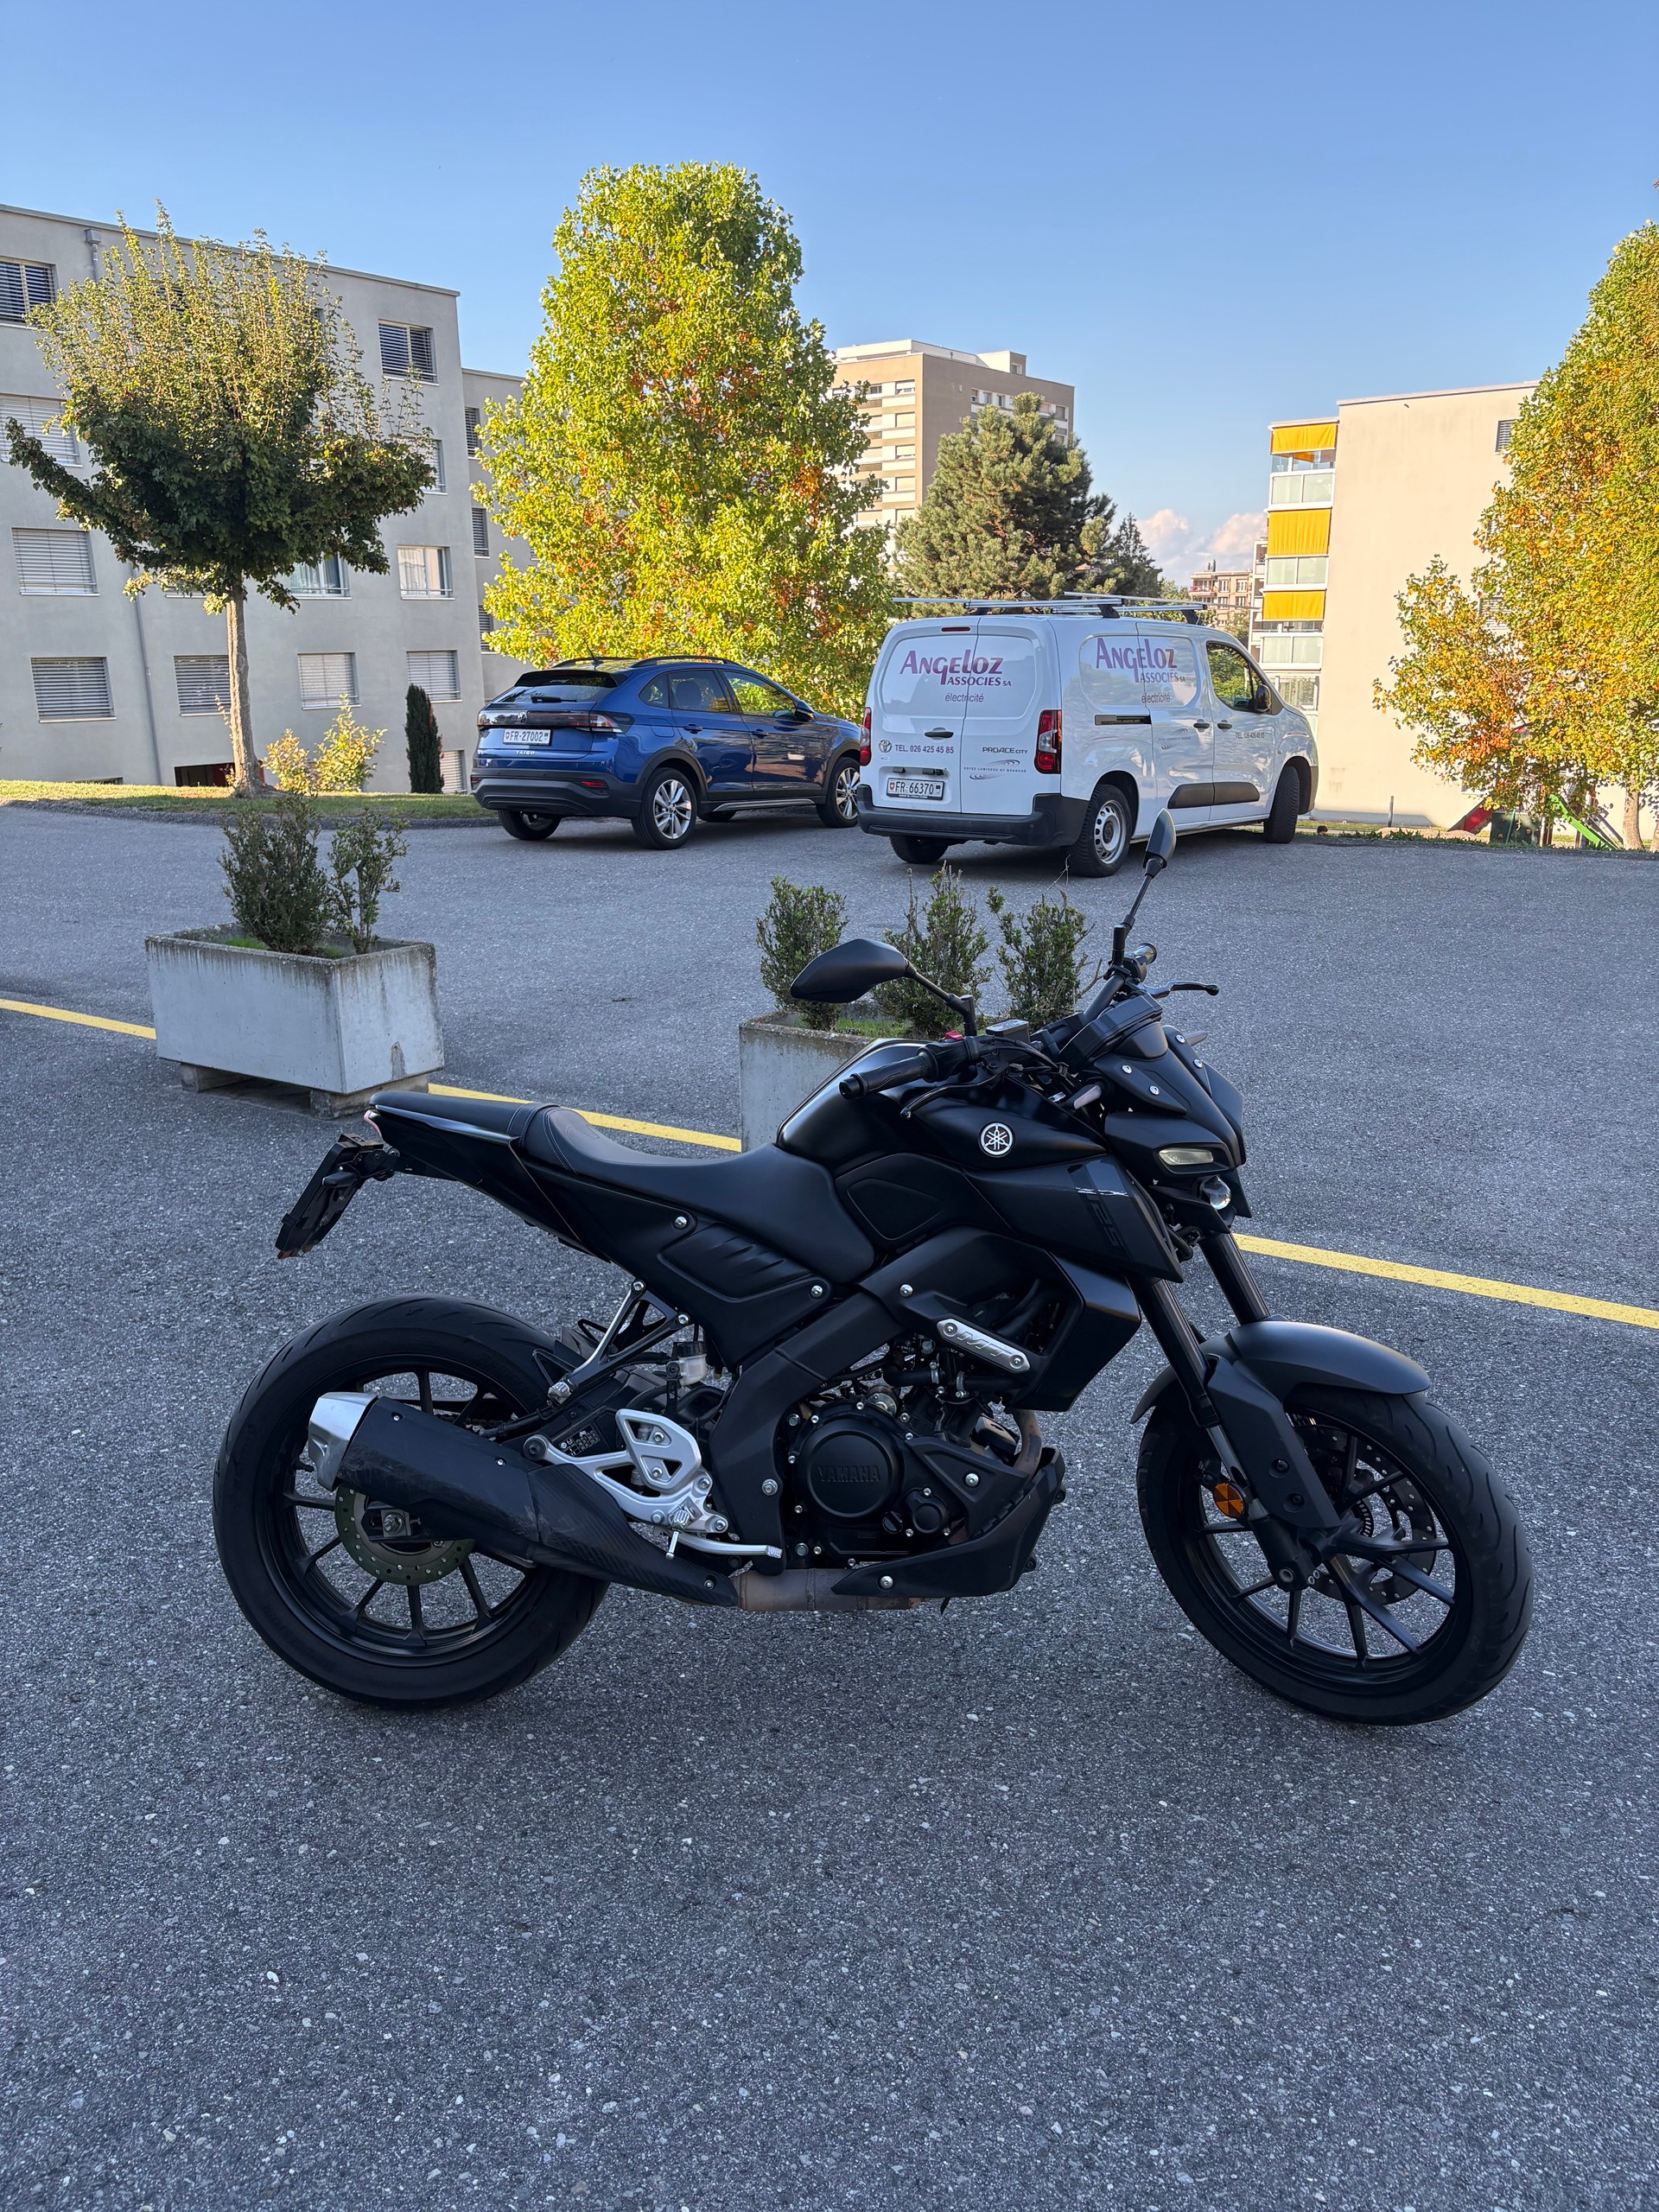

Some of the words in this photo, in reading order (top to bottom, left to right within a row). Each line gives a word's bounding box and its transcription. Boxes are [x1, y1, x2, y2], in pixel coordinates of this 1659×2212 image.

[947, 676, 1001, 687] ASSOCIES
[1141, 671, 1179, 683] ASSOCIES
[944, 692, 984, 702] électricité
[894, 744, 908, 753] TEL.
[957, 1332, 1013, 1357] MT
[817, 1465, 880, 1483] YAMAHA
